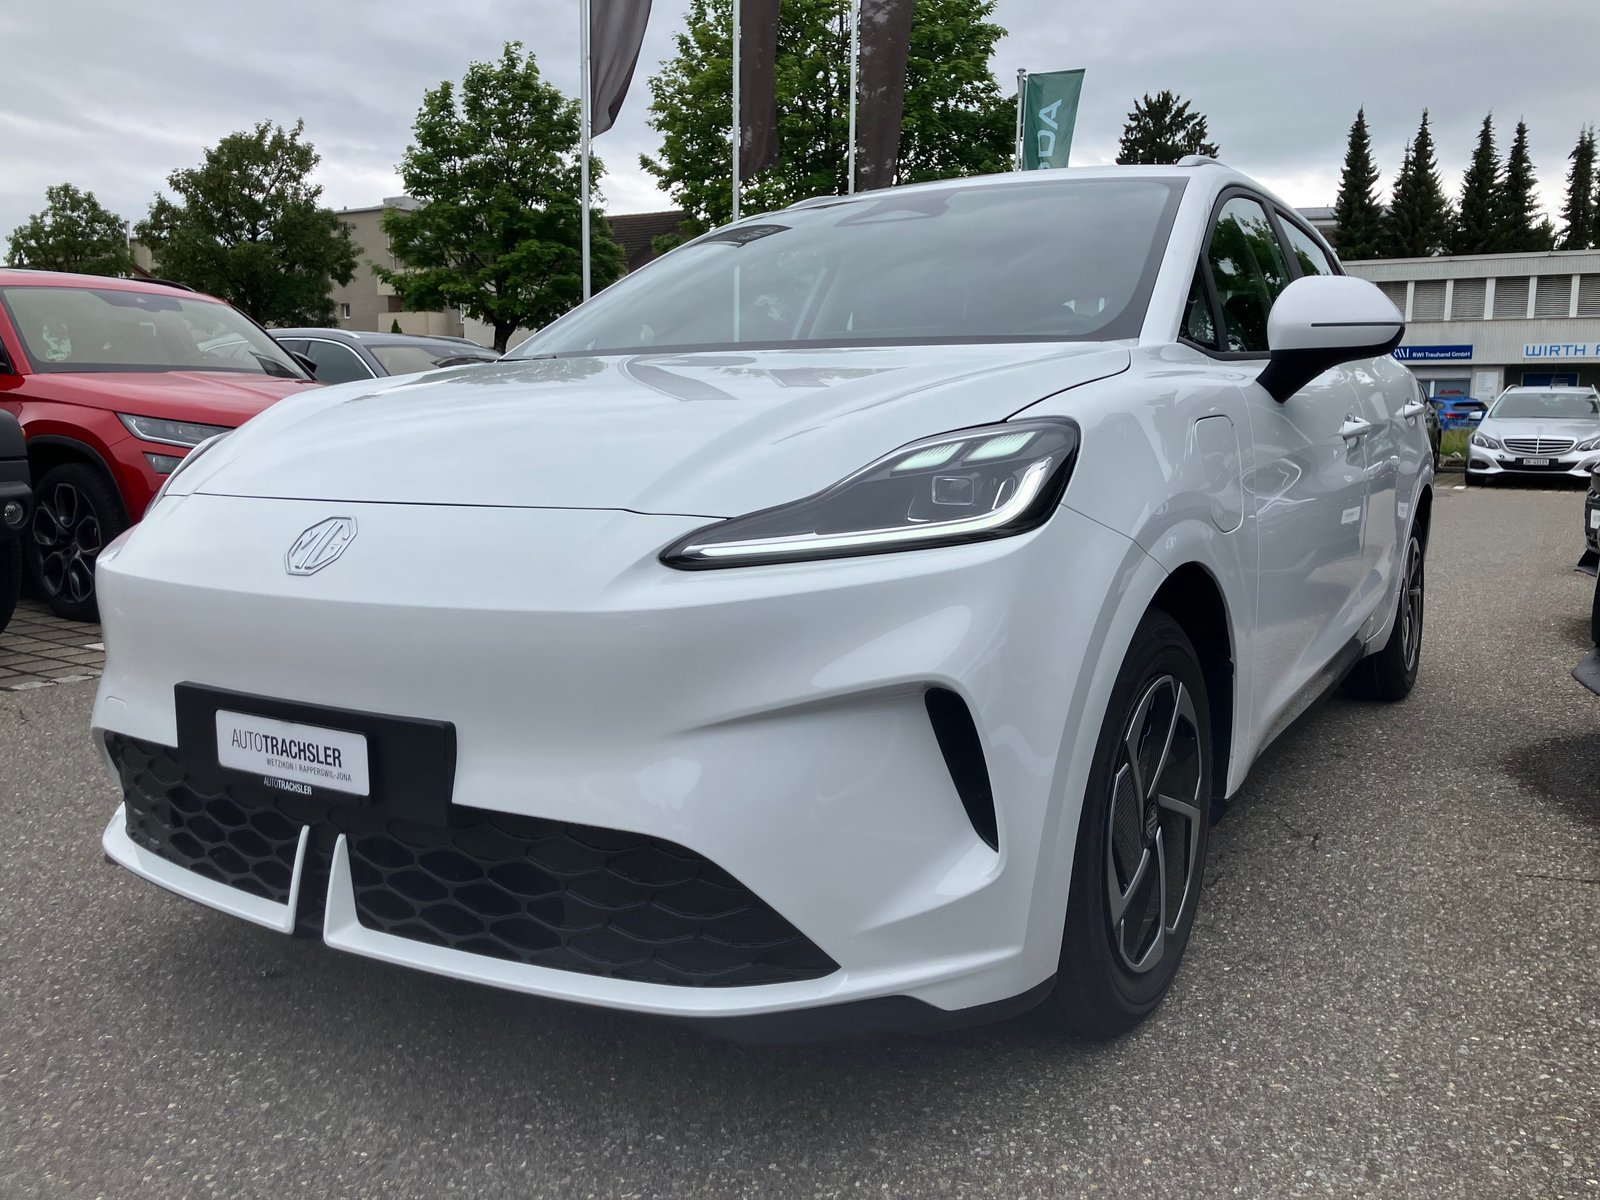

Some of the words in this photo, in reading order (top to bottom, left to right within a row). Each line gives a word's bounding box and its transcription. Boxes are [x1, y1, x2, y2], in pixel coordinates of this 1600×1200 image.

[1525, 344, 1586, 356] WIRTH
[231, 728, 342, 768] AUTOTRACHSLER
[267, 757, 294, 772] WETZIKON
[299, 763, 352, 783] RAPPERSWIL-JONA
[263, 776, 313, 796] AUTOTRACHSLER
